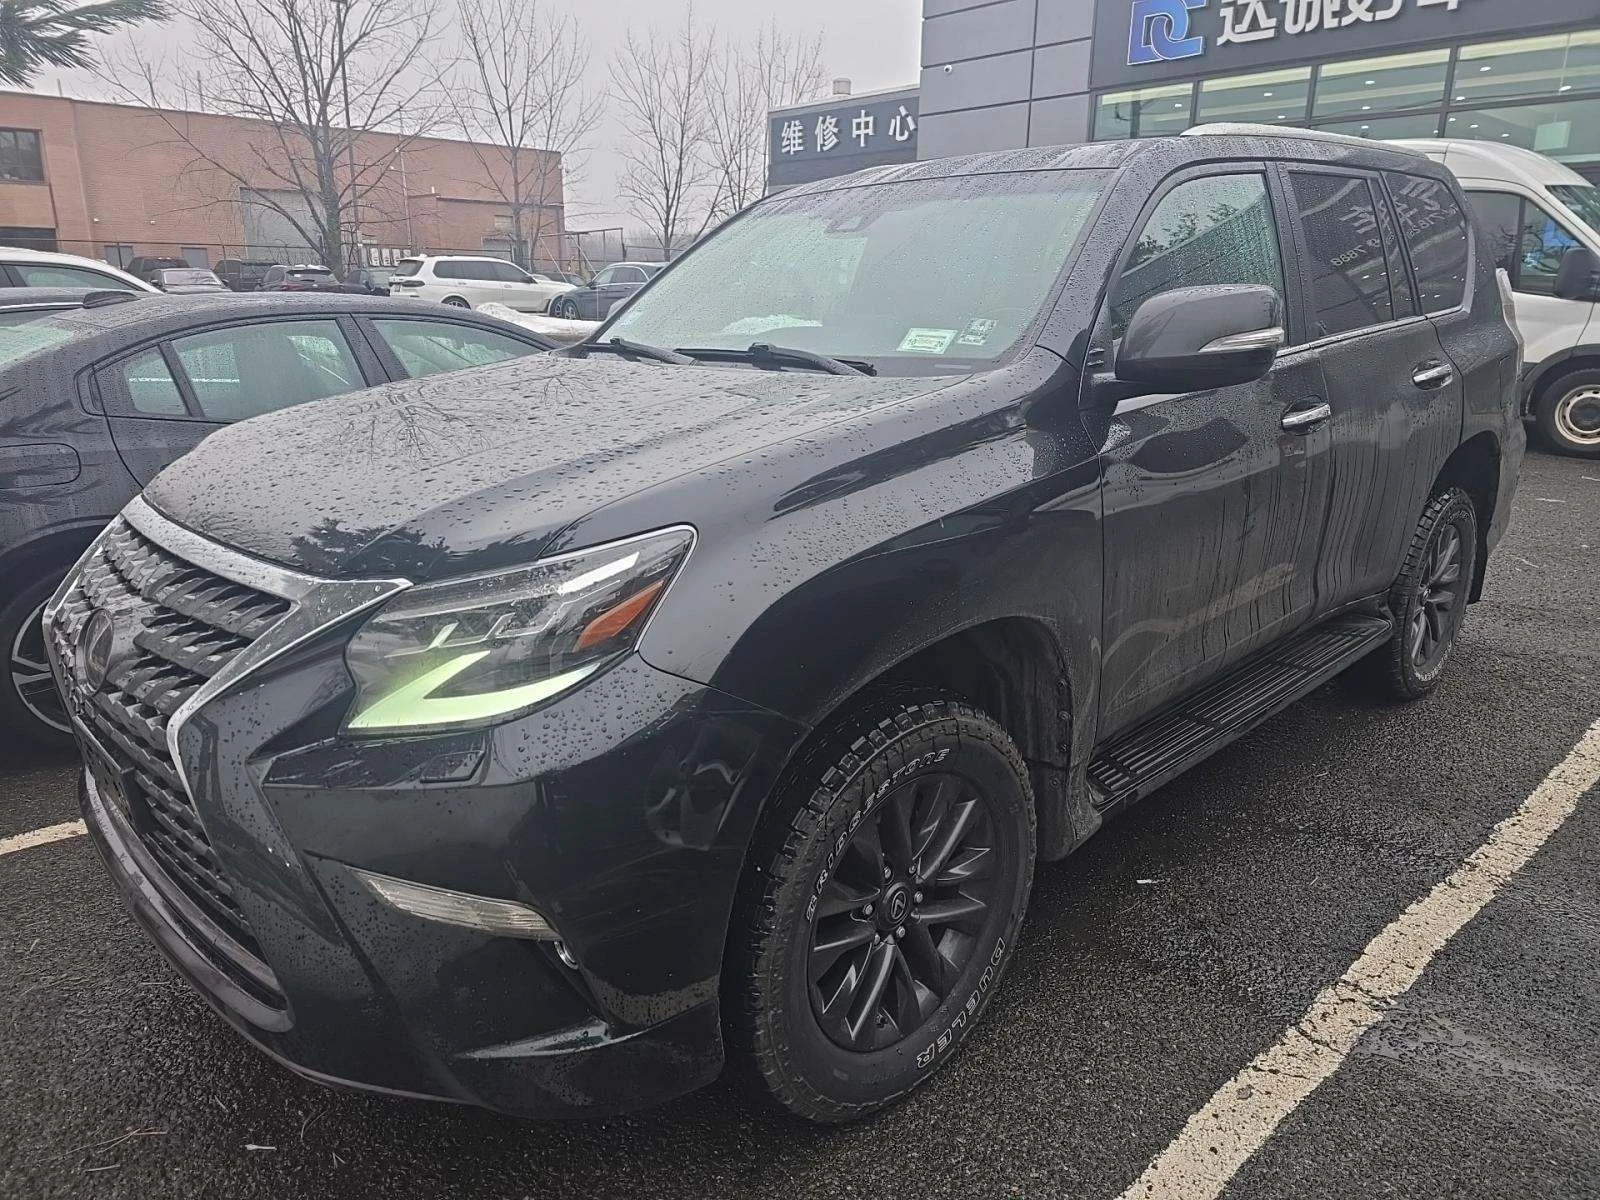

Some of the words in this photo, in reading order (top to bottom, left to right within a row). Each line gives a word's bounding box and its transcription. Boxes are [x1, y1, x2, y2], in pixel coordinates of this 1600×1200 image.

[1216, 0, 1459, 46] 达诚
[781, 105, 917, 155] 维修中心
[916, 937, 1006, 1069] DUELER
